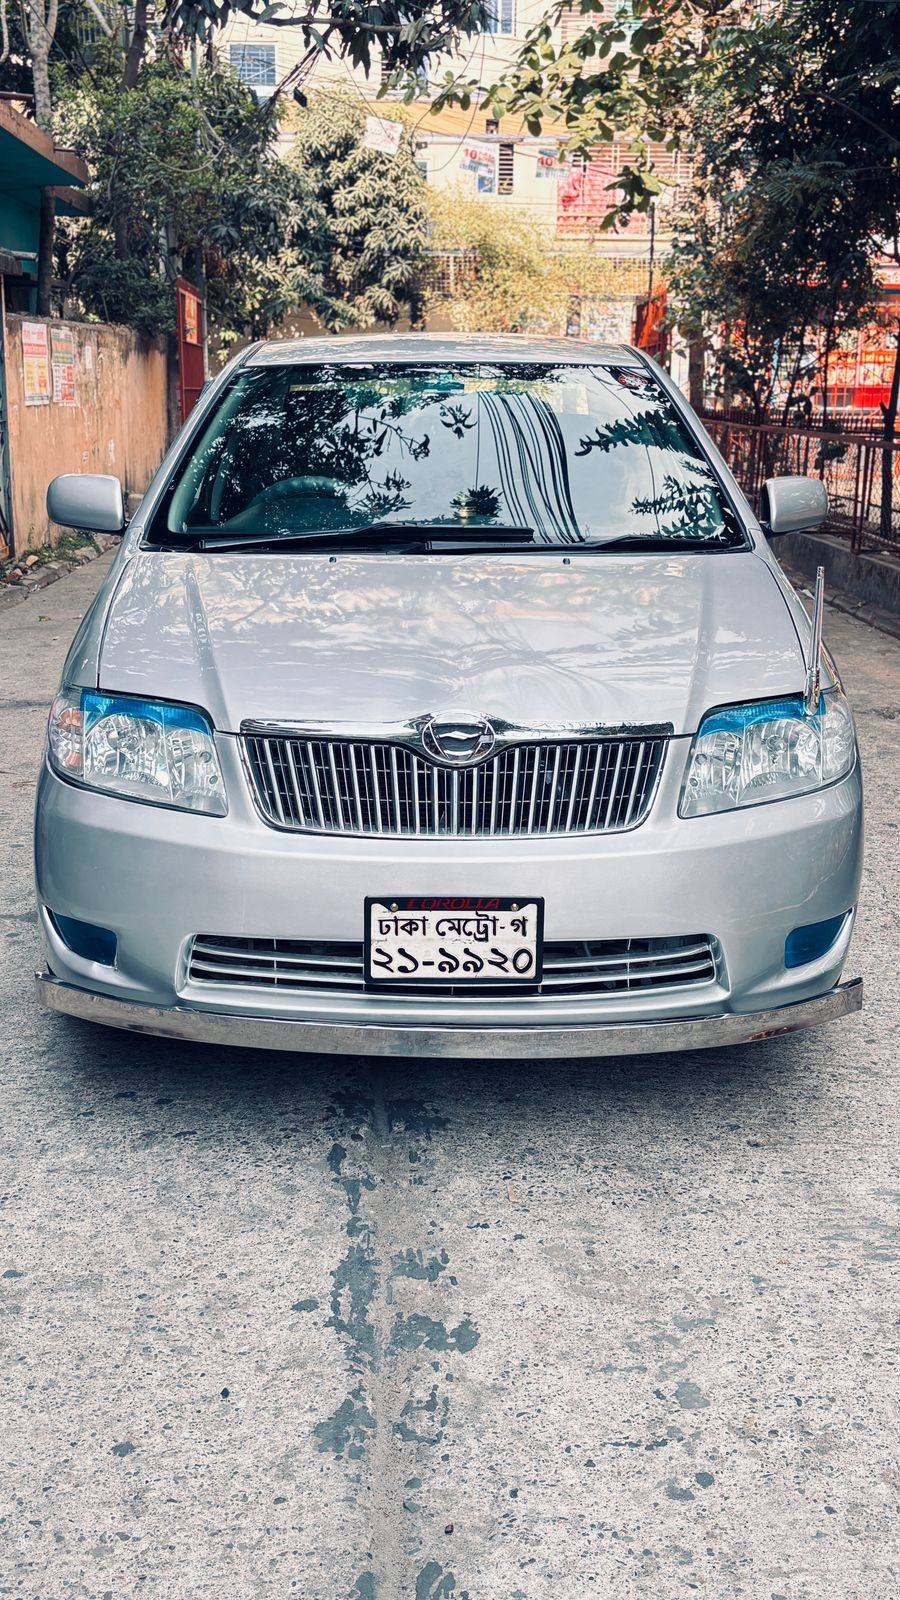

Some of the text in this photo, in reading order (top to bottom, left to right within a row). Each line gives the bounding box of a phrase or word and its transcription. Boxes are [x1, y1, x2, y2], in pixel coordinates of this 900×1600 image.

[406, 897, 500, 910] COROLLA
[378, 916, 428, 937] ঢাকা
[373, 947, 533, 974] ২১-৯৯২০
